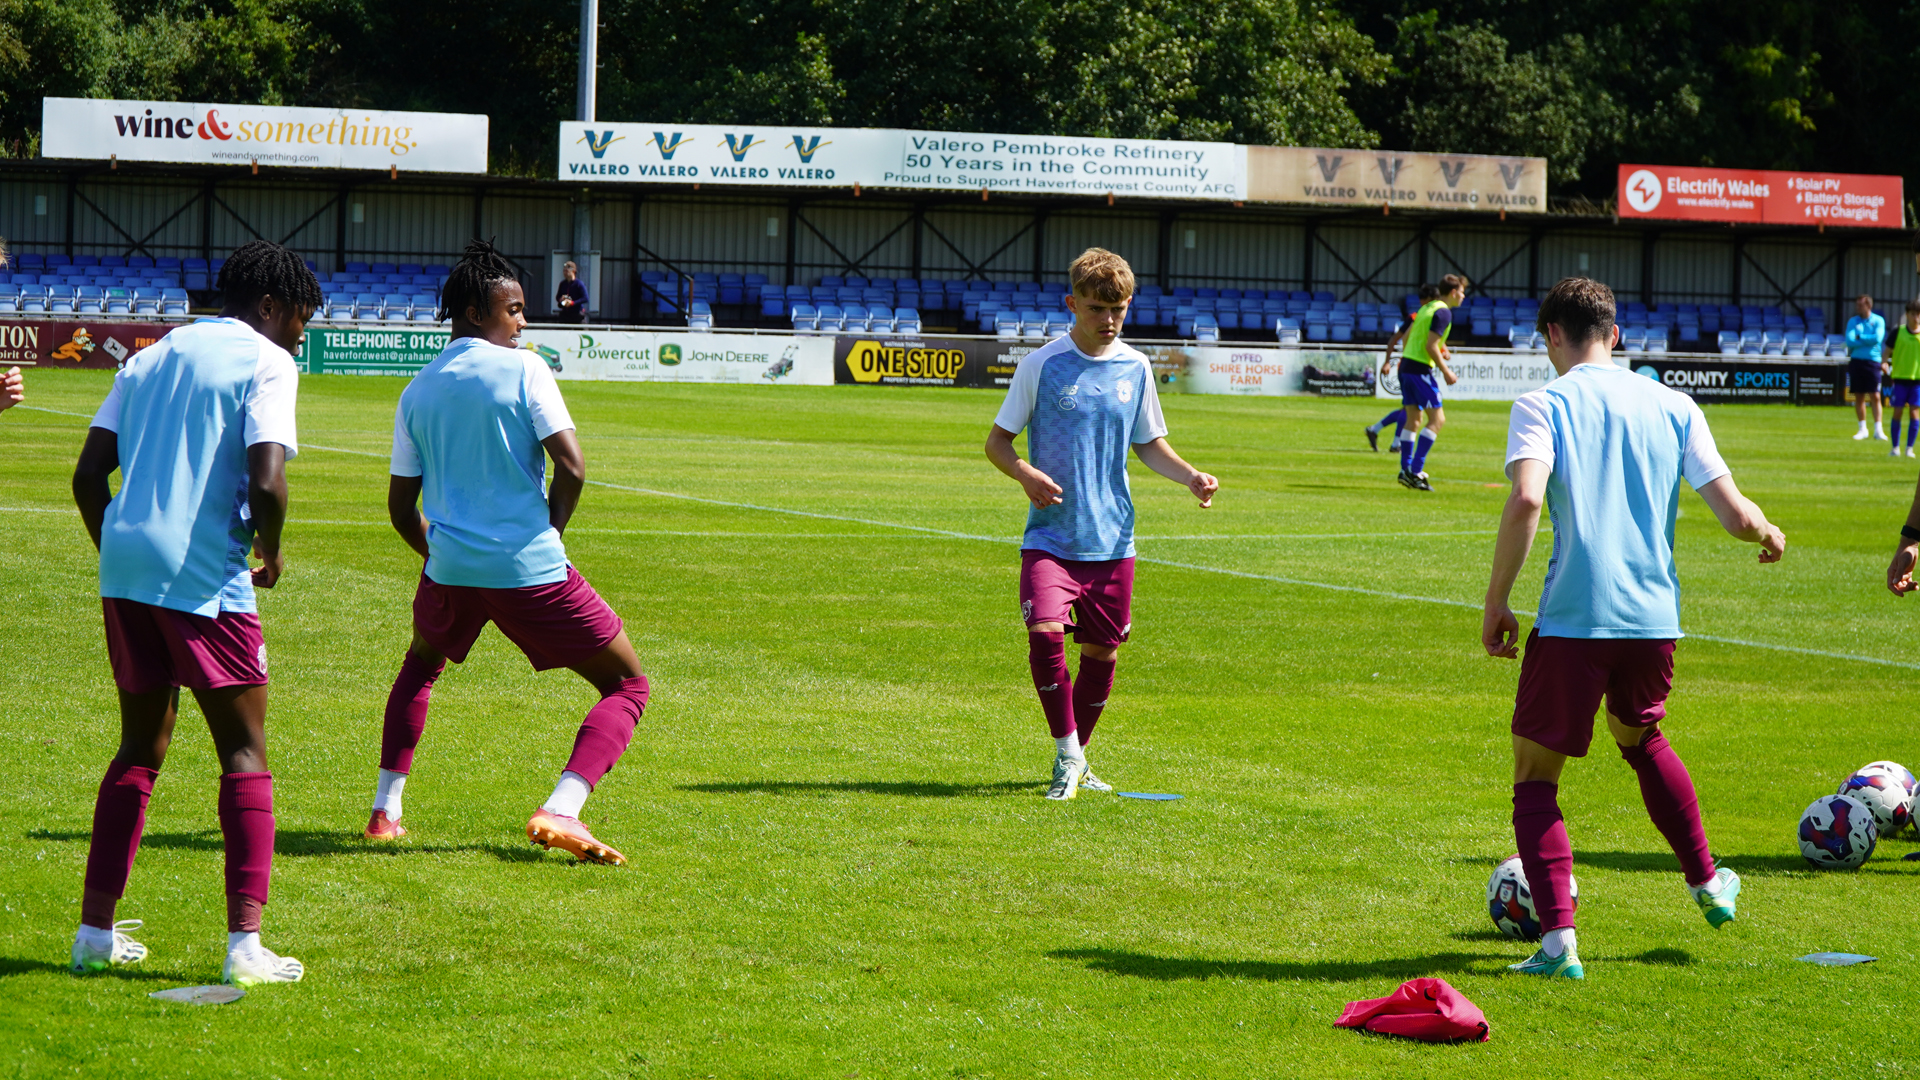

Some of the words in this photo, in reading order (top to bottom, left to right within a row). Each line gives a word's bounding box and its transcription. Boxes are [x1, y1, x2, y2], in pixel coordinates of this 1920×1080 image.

[114, 109, 194, 139] wine
[197, 109, 233, 141] &
[236, 116, 418, 156] something.
[211, 150, 320, 164] wineandsomething.com
[911, 136, 984, 153] Valero
[993, 139, 1106, 158] Pembroke
[1114, 144, 1205, 164] Refinery
[569, 163, 630, 176] VALERO
[638, 165, 699, 177] VALERO
[710, 166, 769, 179] VALERO
[777, 168, 836, 180] VALERO
[906, 154, 932, 169] 50
[940, 154, 1004, 172] Years
[1013, 157, 1032, 172] in
[1040, 159, 1075, 174] the
[1083, 160, 1209, 181] Community
[884, 171, 932, 184] Proud
[936, 174, 952, 185] to
[957, 174, 1021, 188] Support
[1026, 177, 1139, 192] Haverfordwest
[1143, 181, 1198, 195] County
[1203, 183, 1236, 194] AFC
[1667, 175, 1725, 199] Electrify
[1727, 179, 1770, 198] Wales
[1796, 177, 1823, 190] Solar
[1825, 179, 1840, 191] PV
[1303, 185, 1357, 199] VALERO
[1364, 187, 1417, 201] VALERO
[1427, 190, 1479, 204] VALERO
[1486, 192, 1538, 206] VALERO
[1677, 196, 1755, 210] www.electrify.wales
[1805, 191, 1843, 206] Battery
[1844, 193, 1885, 208] Storage
[1813, 205, 1829, 217] EV
[1830, 205, 1879, 222] Charging
[324, 332, 407, 350] TELEPHONE:
[409, 334, 451, 350] 01437
[577, 334, 651, 360] Powercut
[24, 350, 38, 360] Co
[687, 350, 723, 362] JOHN
[725, 351, 769, 363] DEERE
[860, 347, 905, 377] ONE
[906, 348, 966, 379] STOP
[1230, 352, 1263, 363] DYFED
[623, 362, 650, 371] .co.uk
[1209, 363, 1242, 374] SHIRE
[1245, 364, 1285, 376] HORSE
[1499, 361, 1523, 380] foot
[1528, 363, 1550, 380] and
[1230, 374, 1263, 386] FARM
[1663, 369, 1729, 387] COUNTY
[1734, 371, 1790, 388] SPORTS
[1696, 388, 1731, 396] ADVENTURE
[1738, 388, 1767, 397] SPORTING
[1768, 389, 1790, 398] GOODS
